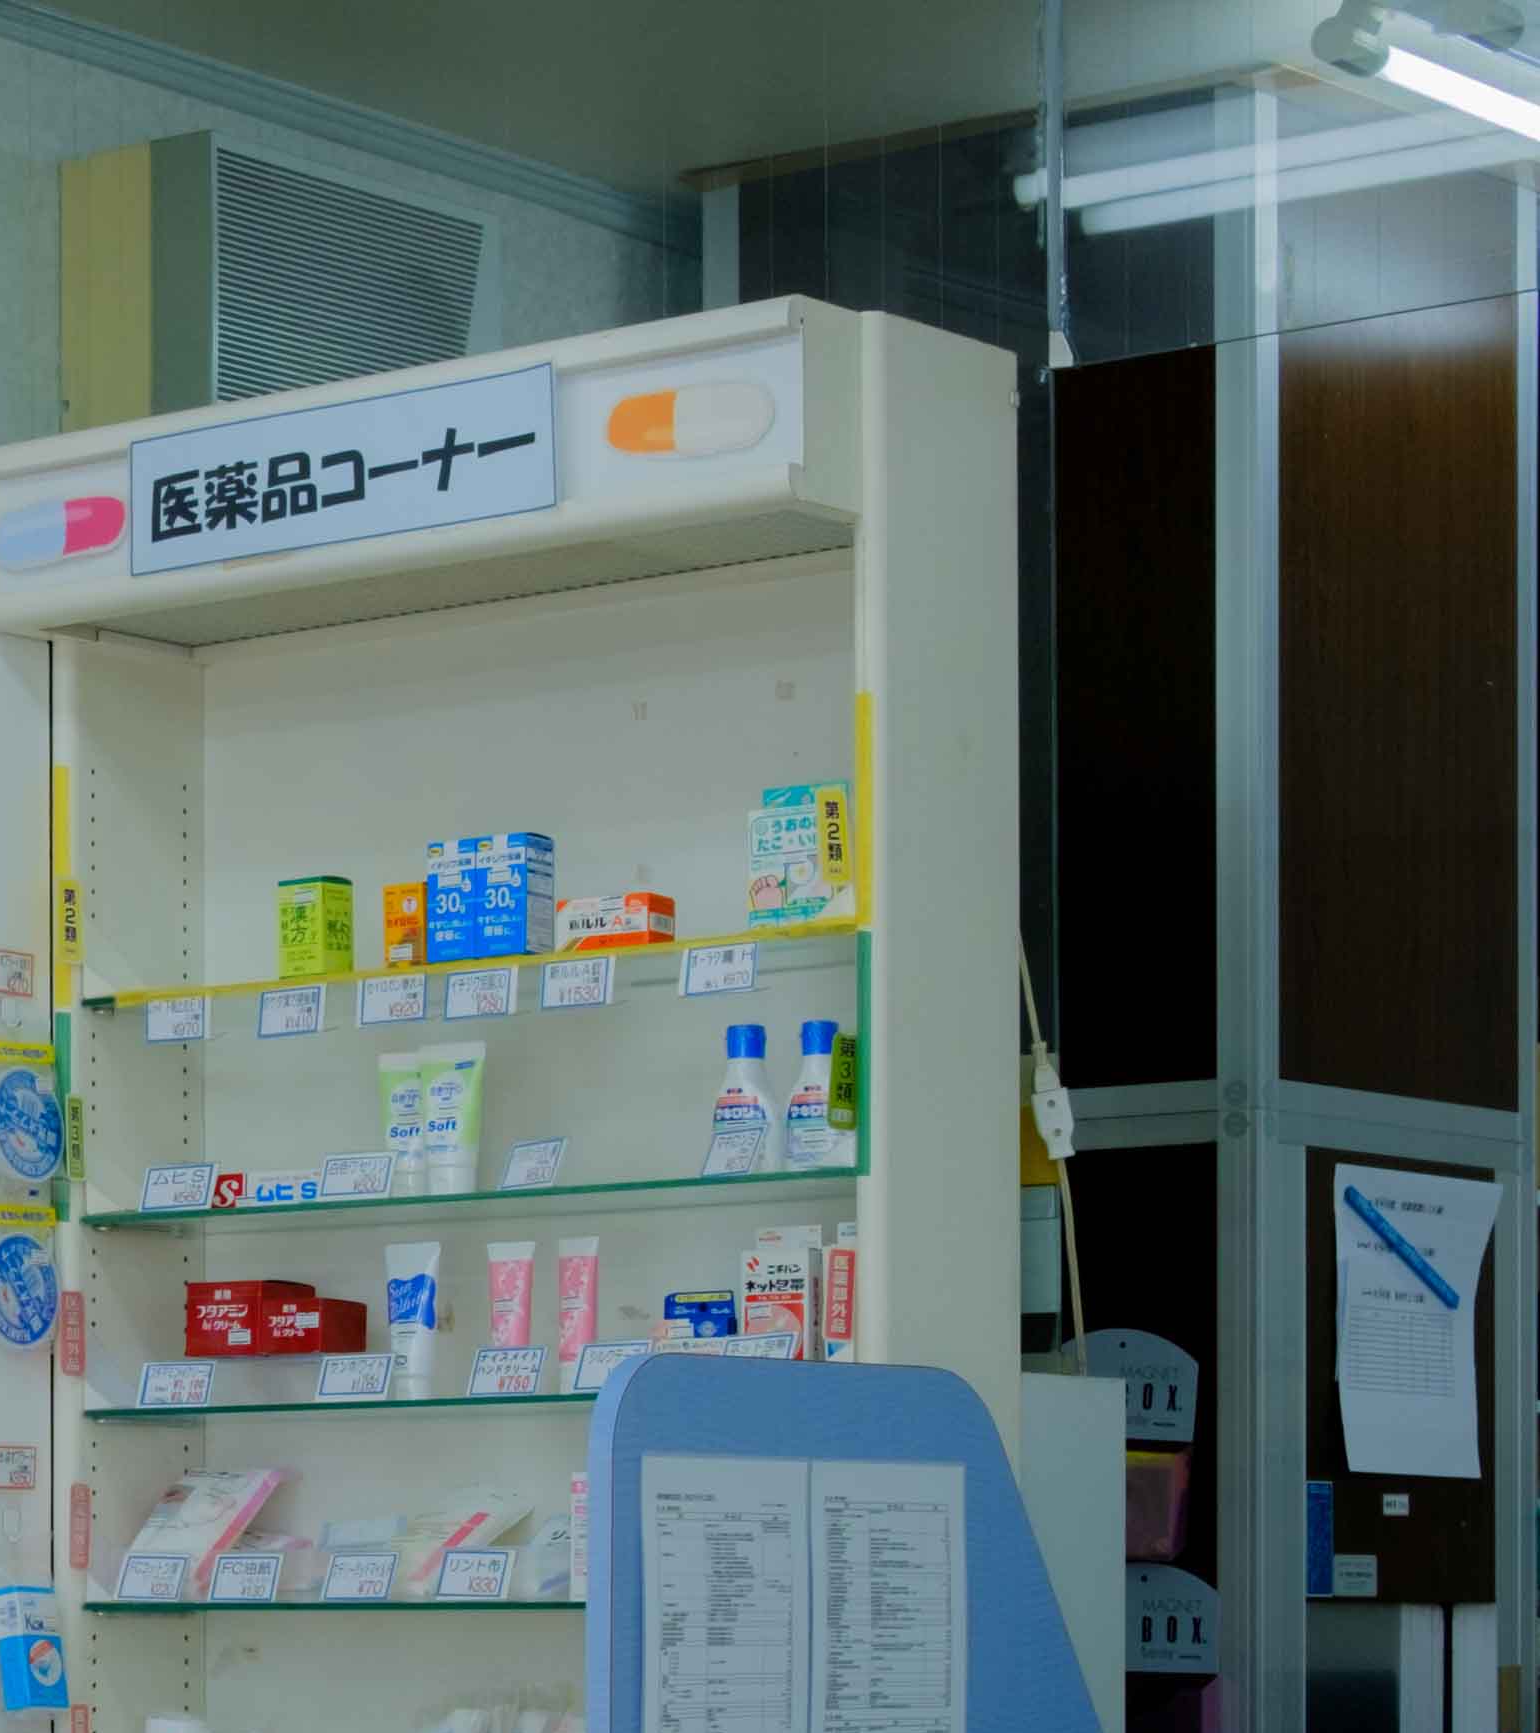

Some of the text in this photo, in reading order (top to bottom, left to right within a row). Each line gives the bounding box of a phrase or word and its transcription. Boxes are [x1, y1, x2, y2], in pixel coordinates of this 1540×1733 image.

[151, 426, 537, 544] 医薬品コーナー
[427, 1118, 458, 1133] Soft
